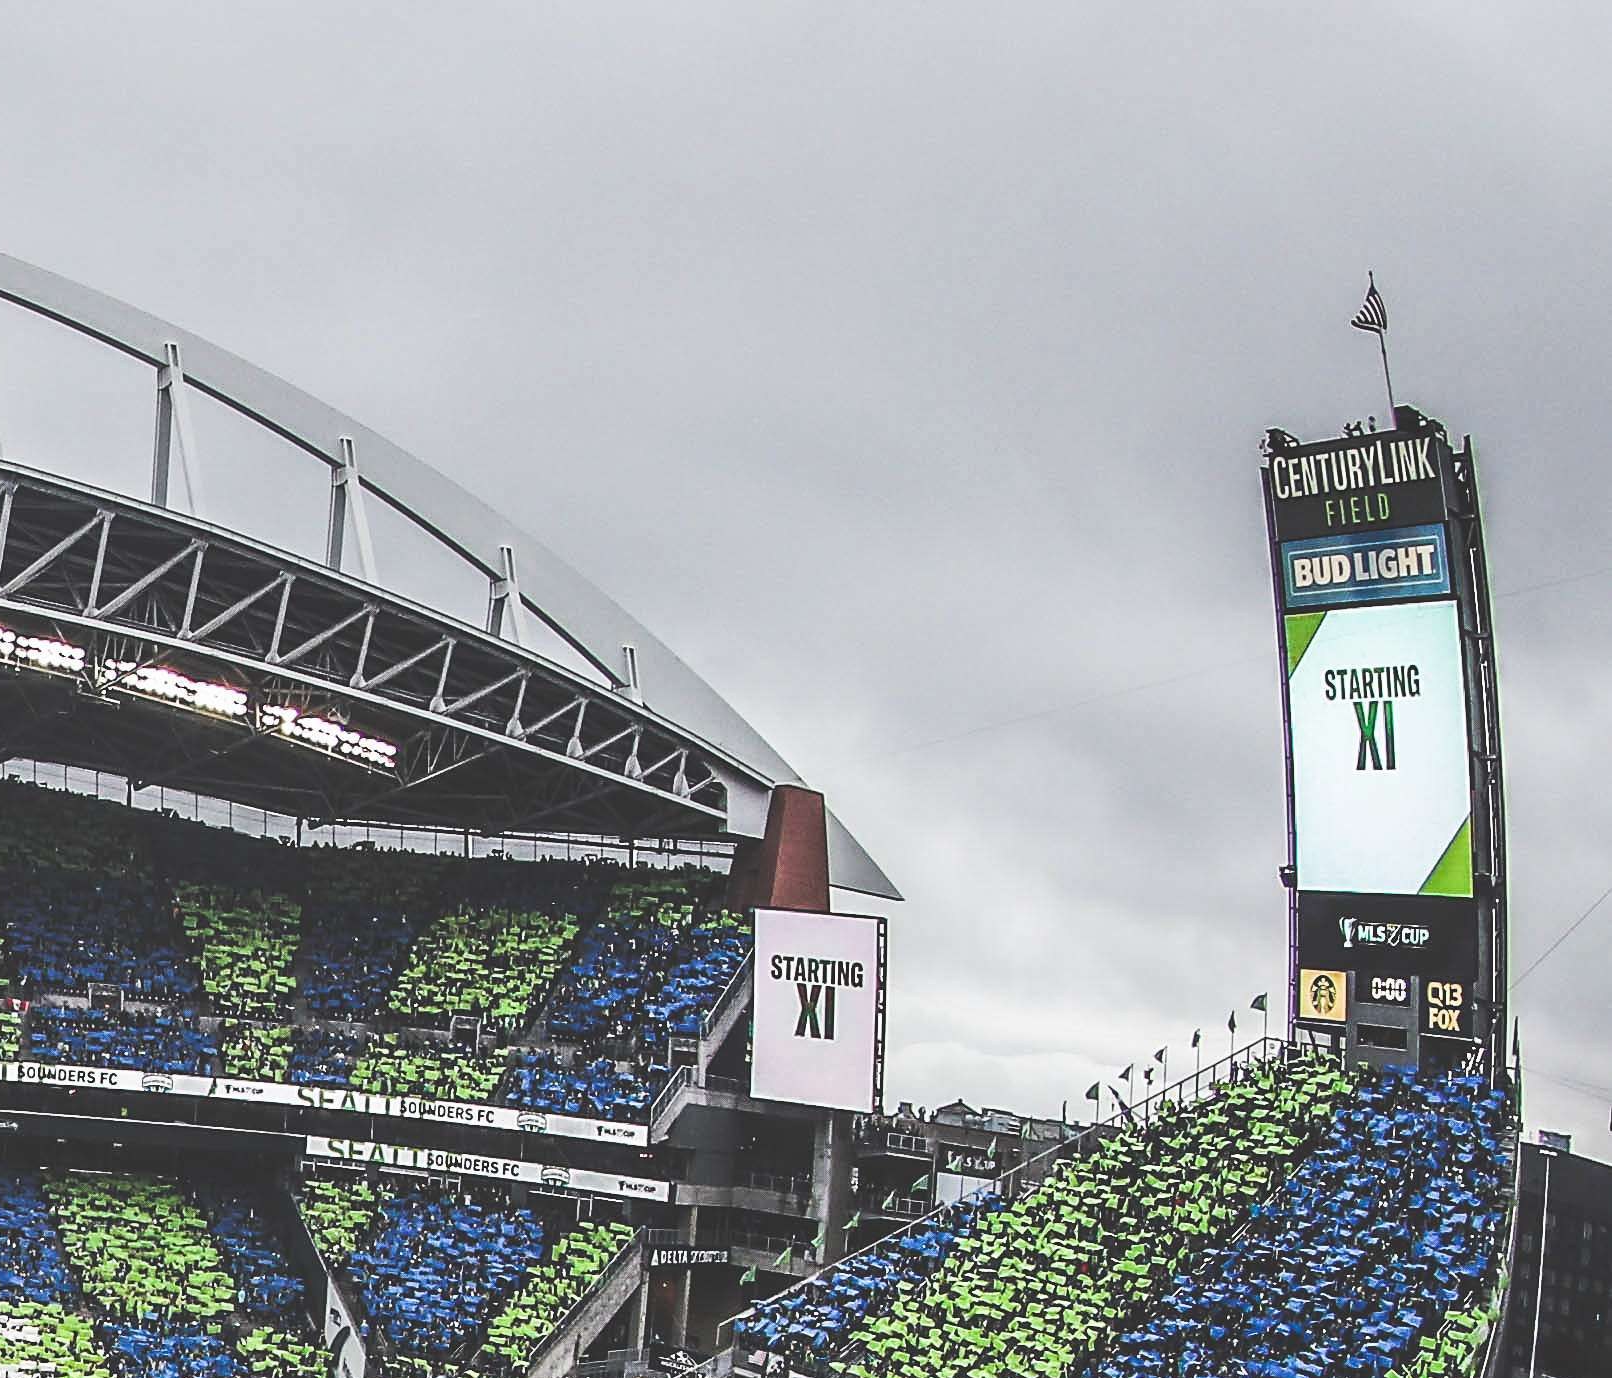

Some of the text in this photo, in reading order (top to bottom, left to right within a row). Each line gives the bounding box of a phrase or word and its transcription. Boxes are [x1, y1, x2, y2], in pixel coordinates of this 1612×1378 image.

[1272, 436, 1437, 500] CENTURYLINK
[1324, 491, 1392, 528] FIELD
[1292, 543, 1437, 589] BUD LIGHT
[1324, 663, 1421, 702] STARTING
[1353, 699, 1397, 771] XI
[1357, 924, 1431, 946] MLS CUP
[770, 954, 864, 988] STARTING
[1370, 976, 1408, 1002] 0:00
[1427, 981, 1464, 1007] Q13
[794, 986, 835, 1041] XI
[1428, 1005, 1461, 1032] FOX
[17, 1064, 119, 1086] SOUNDERS FC
[399, 1099, 495, 1124] SOUNDERS FC
[427, 1152, 520, 1177] SOUNDERS FC
[660, 1250, 688, 1264] DELTA
